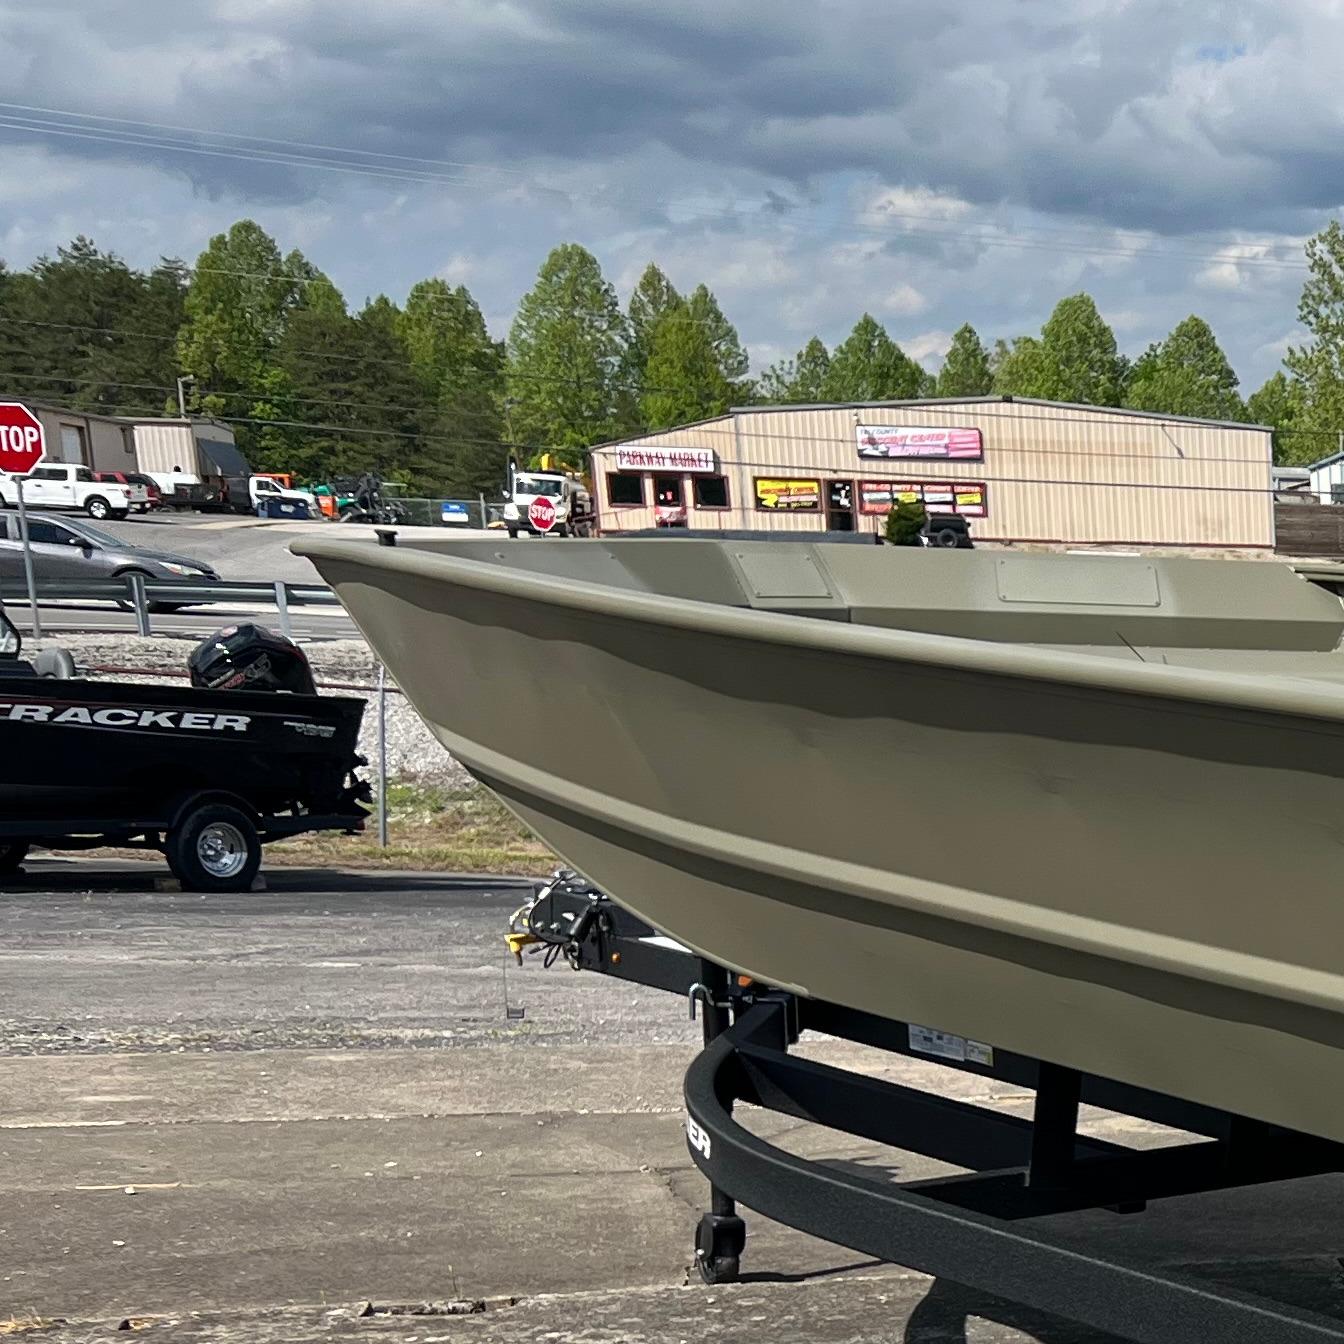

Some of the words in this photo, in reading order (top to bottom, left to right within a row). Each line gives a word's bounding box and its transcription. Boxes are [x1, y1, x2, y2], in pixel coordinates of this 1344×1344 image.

[0, 425, 39, 452] TOP
[619, 450, 665, 467] PARKWAY
[669, 451, 708, 468] MARKET
[530, 506, 555, 520] STOP
[0, 704, 251, 731] RACKER
[687, 1115, 711, 1159] ER
